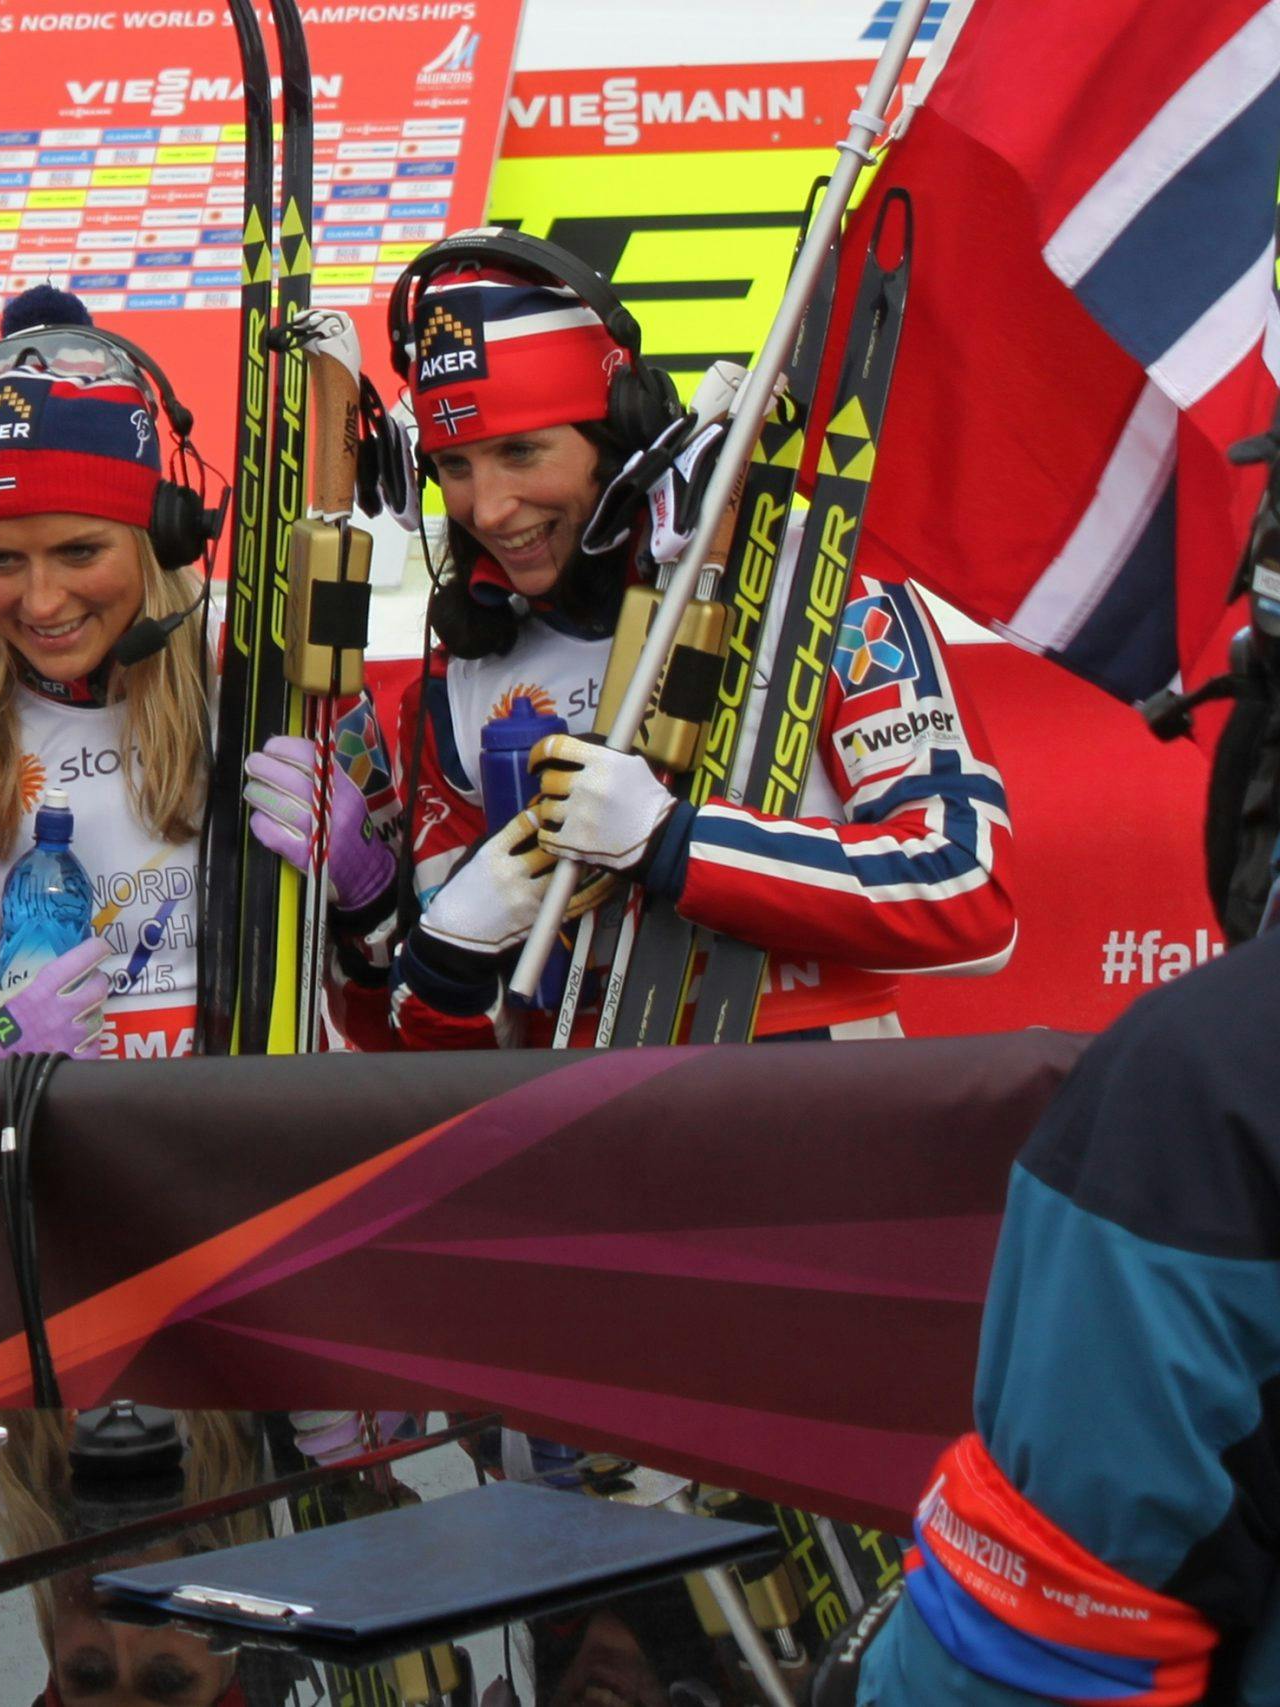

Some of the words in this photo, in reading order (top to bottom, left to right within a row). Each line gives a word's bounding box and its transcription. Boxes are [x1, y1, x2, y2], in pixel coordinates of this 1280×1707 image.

[20, 12, 116, 31] NORDIC
[123, 10, 215, 28] WORLD
[268, 4, 476, 24] AMPIONSHIPS
[507, 77, 805, 146] VIESSMANN
[421, 350, 477, 380] AKER
[234, 308, 267, 658] FISCHER
[690, 491, 786, 804] FISCHER
[761, 504, 858, 816] FISCHER
[862, 709, 955, 753] weber
[1041, 1585, 1150, 1618] VIESSMANN
